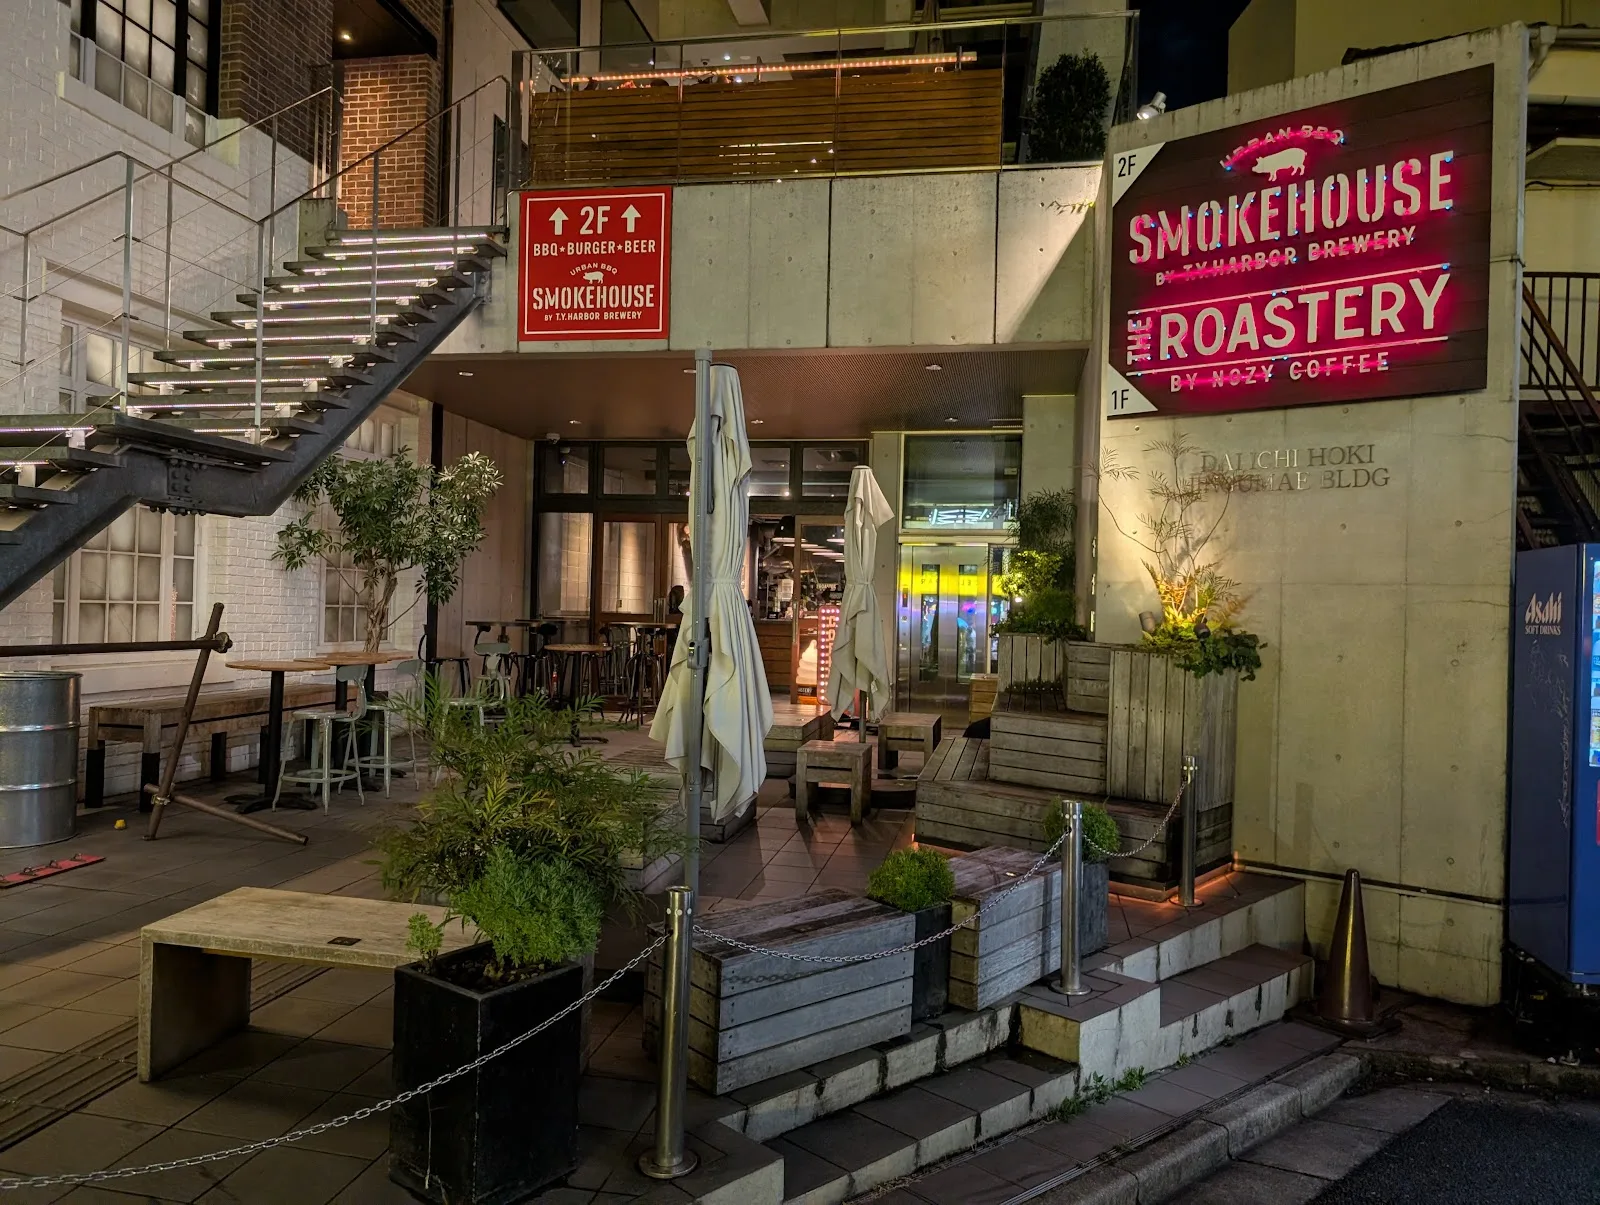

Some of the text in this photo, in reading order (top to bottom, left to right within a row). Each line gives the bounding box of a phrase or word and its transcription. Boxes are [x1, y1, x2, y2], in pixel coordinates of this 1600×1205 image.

[1117, 154, 1137, 178] 2F
[1129, 150, 1454, 264] SMOKEHOUSE
[579, 205, 611, 235] 2F
[533, 239, 656, 256] BBQ BURGER BEER
[1155, 270, 1175, 286] BY
[1308, 225, 1416, 261] BREWERY
[569, 262, 618, 276] URBAN BBQ
[532, 284, 655, 310] SMOKEHOUSE
[603, 311, 642, 320] BREWERY
[1127, 274, 1450, 365] THE ROASTERY
[1170, 352, 1389, 393] BY NOZY COFFEE
[1111, 388, 1130, 410] 1F
[1307, 444, 1376, 467] HOKI
[1320, 468, 1390, 489] BLDG
[1525, 592, 1562, 624] Asahi
[1525, 625, 1561, 636] SOFT DRINKS
